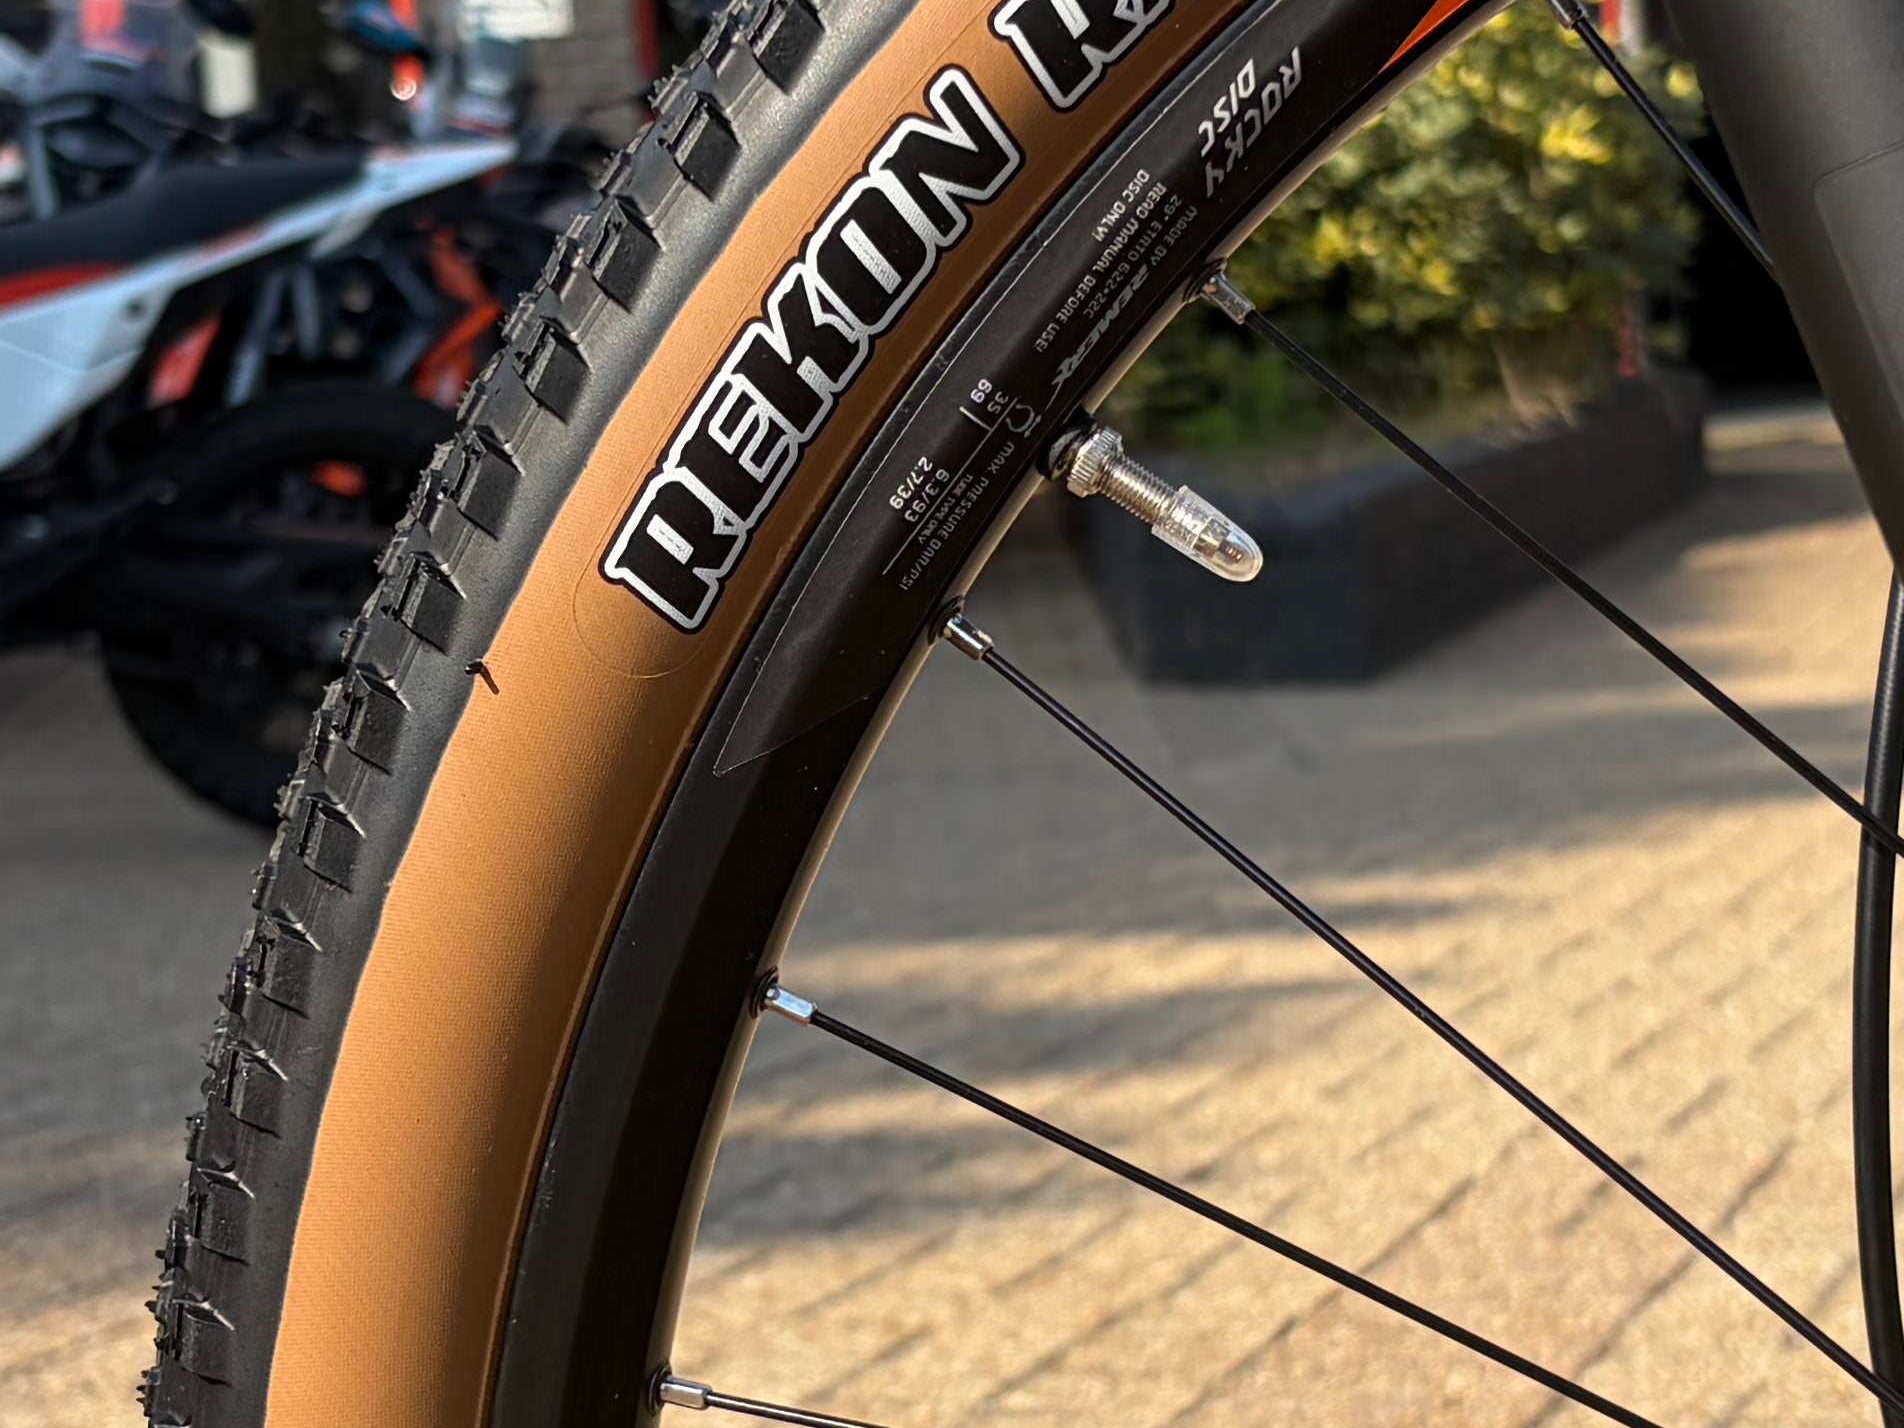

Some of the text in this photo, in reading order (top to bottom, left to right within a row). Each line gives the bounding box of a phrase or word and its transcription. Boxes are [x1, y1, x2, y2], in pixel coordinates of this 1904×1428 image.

[1198, 58, 1257, 157] DISC
[1205, 46, 1302, 198] ROCKY
[1090, 169, 1149, 241] DISC ONLY!
[1127, 221, 1161, 261] ETRTO
[1163, 206, 1197, 245] MADE
[1033, 183, 1166, 351] READ MANUAL BEFORE USE!
[599, 63, 1026, 633] REKON
[888, 378, 991, 509] 69 2.7/39
[904, 391, 1007, 522] 35 6.3/93
[938, 477, 988, 538] PRESSURE
[898, 539, 939, 589] BAR/PSI
